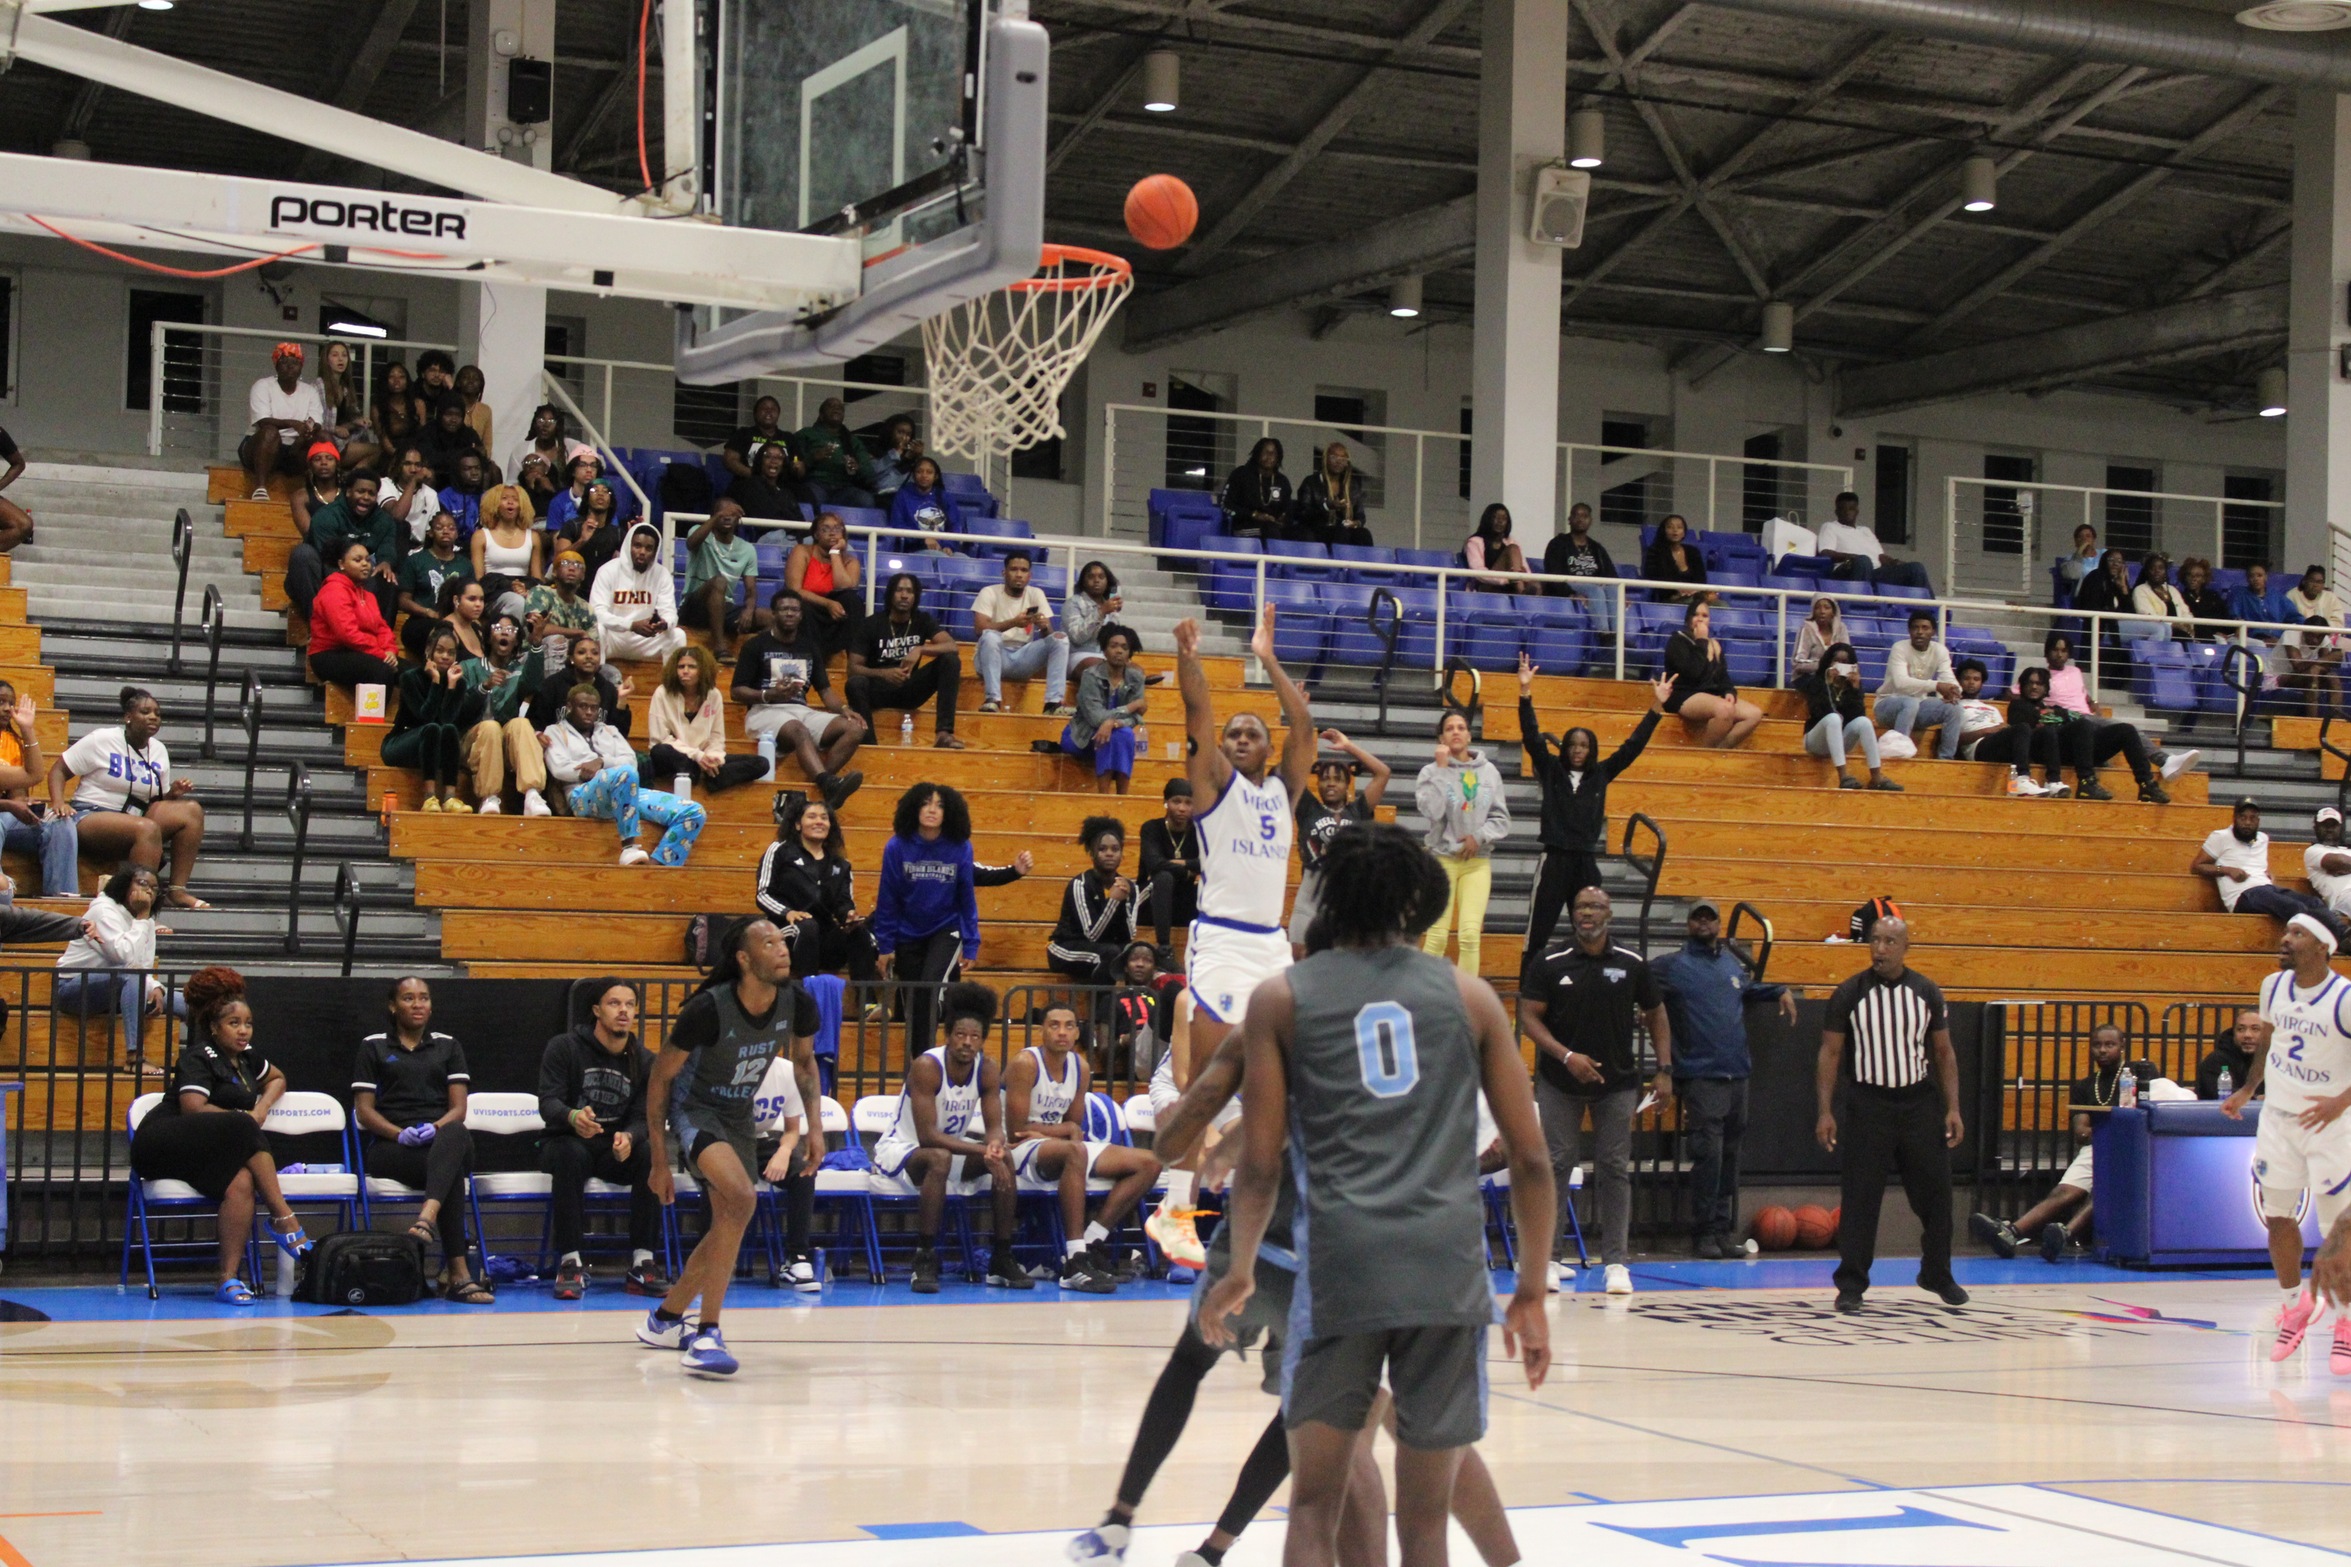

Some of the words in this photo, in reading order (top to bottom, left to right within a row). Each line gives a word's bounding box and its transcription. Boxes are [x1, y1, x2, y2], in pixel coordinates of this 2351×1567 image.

[880, 645, 914, 658] ARGU
[886, 634, 921, 648] NEVER
[1260, 814, 1276, 841] 5
[2274, 1012, 2328, 1038] VIRGIN
[738, 1040, 777, 1058] RUST
[1353, 1000, 1420, 1099] 0
[2288, 1034, 2304, 1061] 2
[730, 1057, 768, 1086] 12
[943, 1114, 967, 1135] 21
[1769, 1326, 2152, 1347] UNITED
